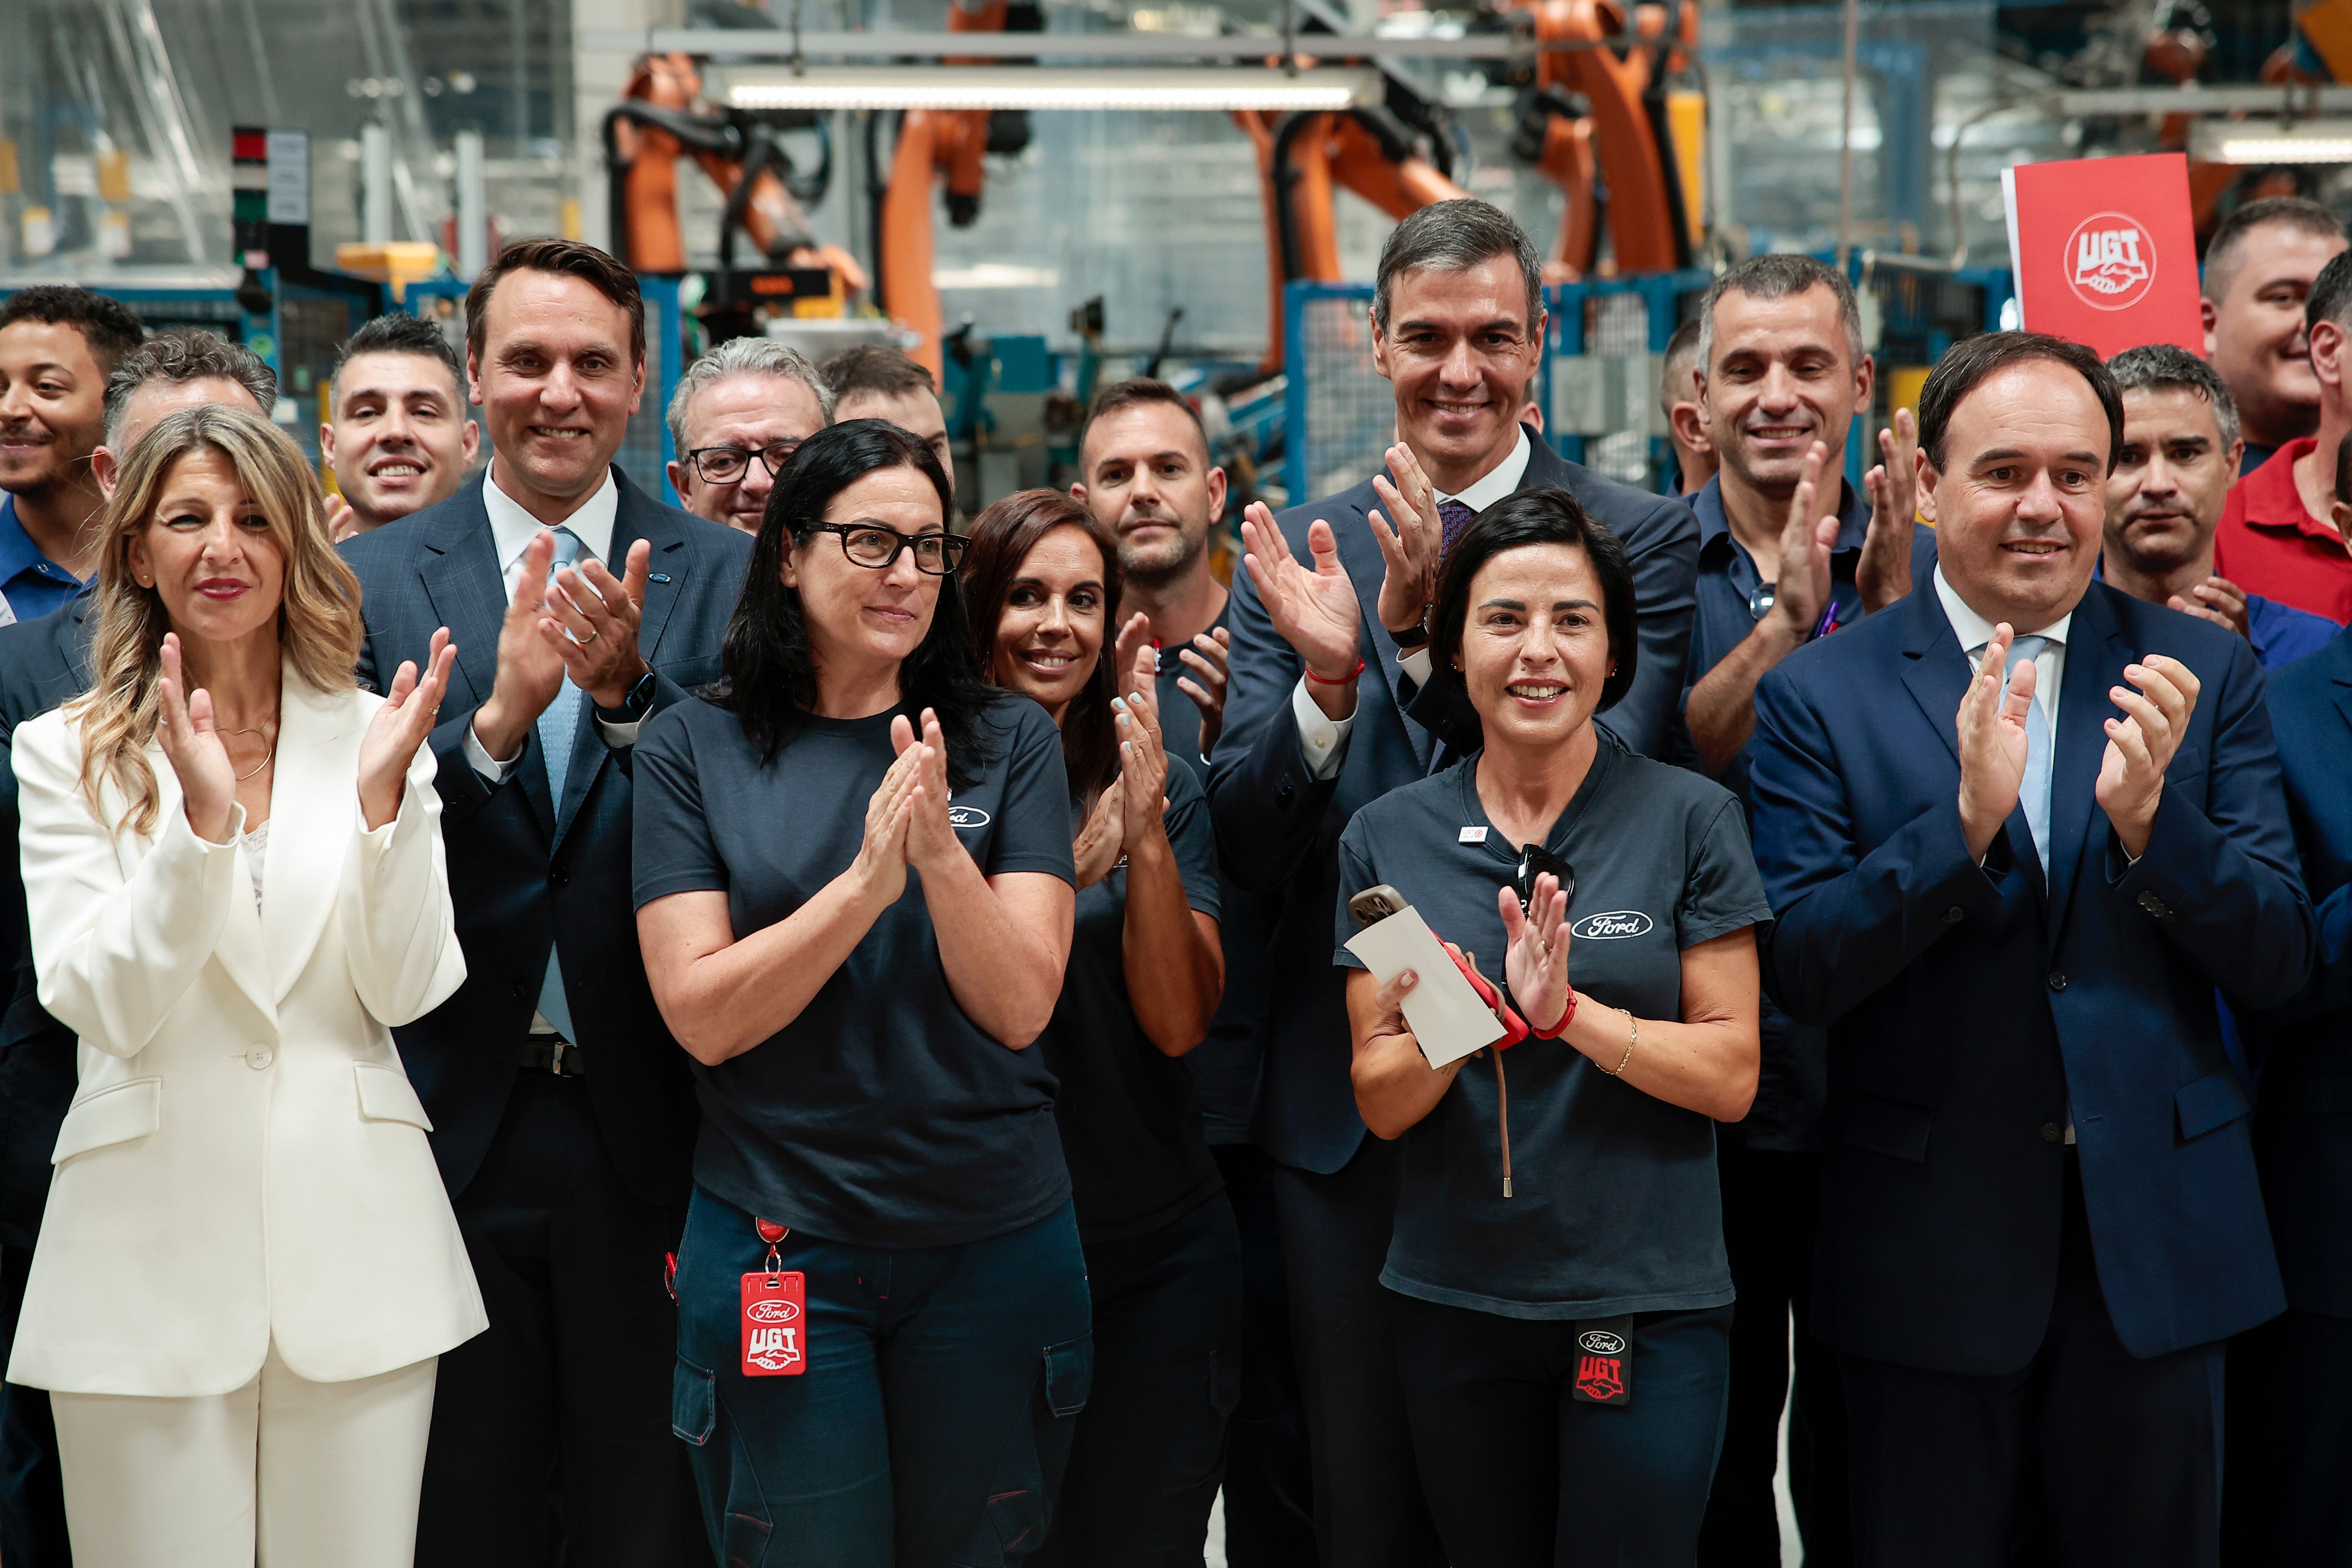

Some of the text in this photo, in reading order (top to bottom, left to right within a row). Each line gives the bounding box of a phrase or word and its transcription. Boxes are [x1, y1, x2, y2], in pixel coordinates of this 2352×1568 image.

[2078, 229, 2140, 271] UGT
[1587, 915, 1640, 936] Ford
[755, 1304, 791, 1319] Ford
[749, 1327, 796, 1354] UGT
[1586, 1334, 1618, 1351] Ford
[1578, 1356, 1621, 1384] UGT
